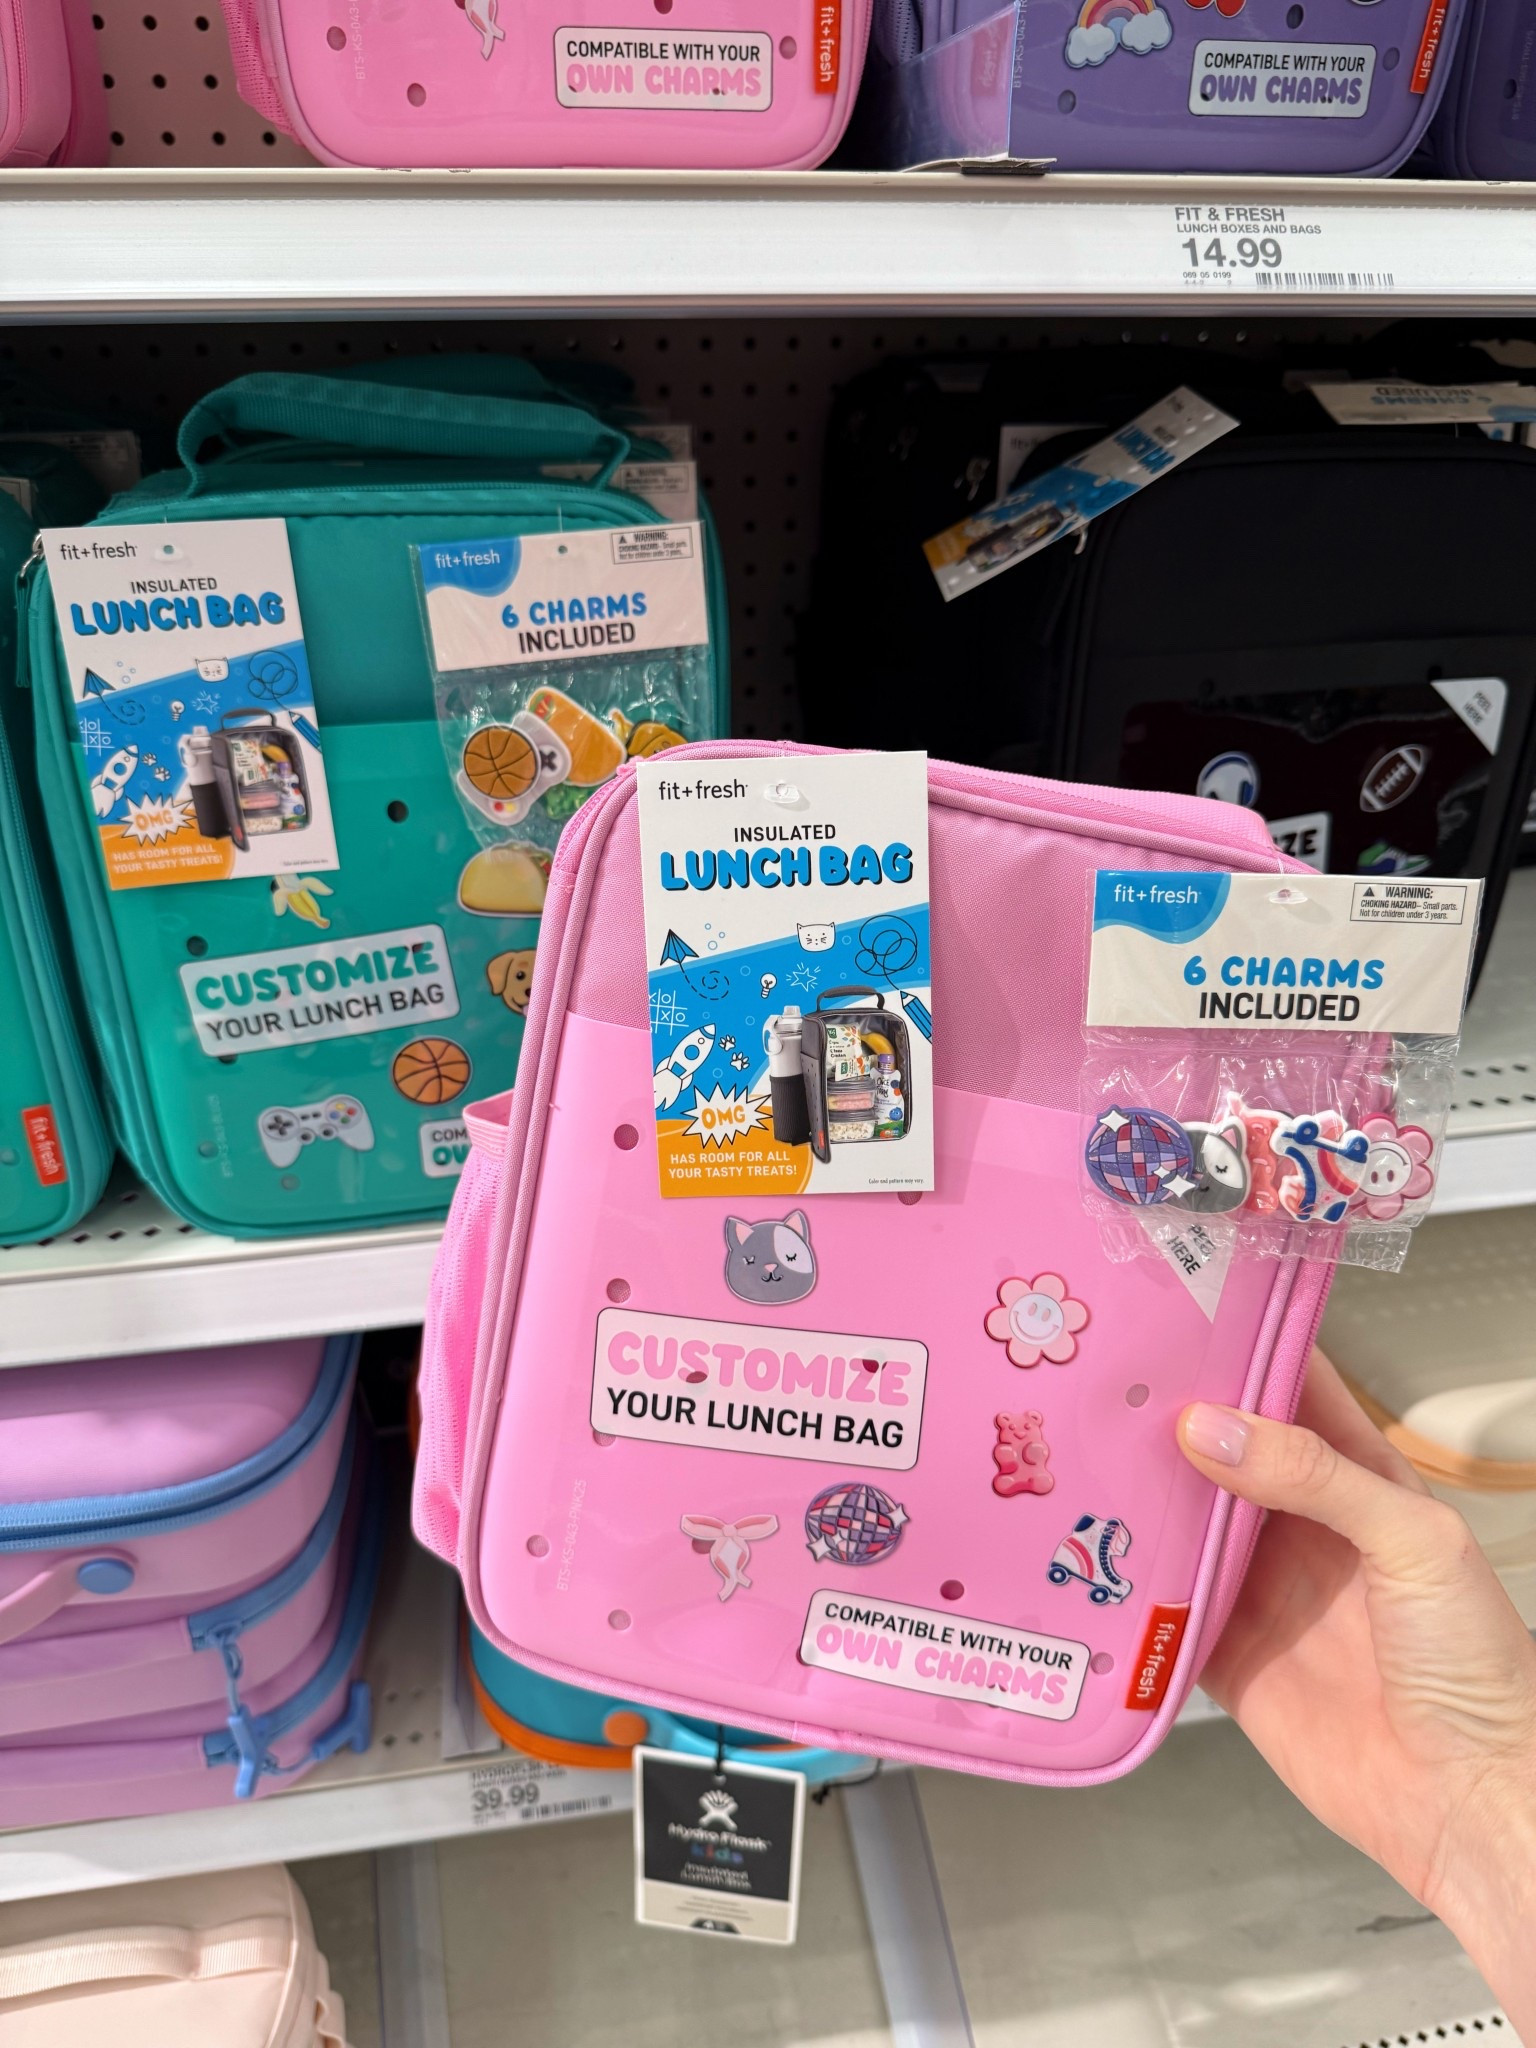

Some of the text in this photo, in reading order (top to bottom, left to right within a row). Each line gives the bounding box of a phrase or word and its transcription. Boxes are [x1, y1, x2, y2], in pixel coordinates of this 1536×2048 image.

[567, 40, 761, 62] COMPATIBLE WITH YOUR
[820, 6, 835, 83] fit+fresh
[1204, 52, 1365, 72] COMPATIBLE WITH YOUR
[566, 63, 762, 97] OWN CHARMS
[1200, 74, 1363, 105] OWN CHARMS
[1175, 207, 1285, 222] FIT & FRESH
[1177, 223, 1322, 235] LUNCH BOXES AND BAGS
[1182, 237, 1282, 268] 14.99
[60, 541, 138, 560] fit+fresh
[435, 550, 501, 569] fit+fresh
[130, 577, 218, 594] INSULATED
[70, 591, 285, 636] LUNCH BAG
[501, 591, 647, 629] 6 CHARMS
[518, 622, 636, 654] INCLUDED
[659, 778, 748, 800] fit+fresh
[135, 813, 174, 832] OMG
[734, 824, 837, 843] INSULATED
[113, 844, 216, 862] HAS ROOM FOR ALL
[113, 855, 223, 874] YOUR TASTY TREATS!
[660, 842, 913, 891] LUNCH BAG
[1114, 884, 1202, 904] fit+fresh
[1385, 886, 1434, 899] WARNING:
[1360, 899, 1389, 909] CHOKING
[1423, 901, 1440, 910] Small
[1441, 902, 1458, 912] parts.
[1360, 908, 1448, 921] Not for children under 3 years.
[195, 941, 440, 1010] CUSTOMIZE
[1183, 954, 1385, 990] 6 CHARMS
[206, 983, 445, 1041] YOUR LUNCH BAG
[1198, 992, 1360, 1022] INCLUDED
[701, 1105, 745, 1129] OMG
[432, 1127, 467, 1142] COM
[670, 1150, 790, 1164] HAS ROOM FOR ALL
[668, 1164, 798, 1179] YOUR TASTY TREATS!
[1166, 1236, 1201, 1275] HERE
[607, 1331, 912, 1407] CUSTOMIZE
[606, 1387, 904, 1448] YOUR LUNCH BAG
[825, 1602, 1073, 1671] COMPATIBLE WITH YOUR
[815, 1623, 1068, 1704] OWN CHARMS
[1136, 1622, 1176, 1698] fit+fresh
[472, 1782, 540, 1812] 39.99
